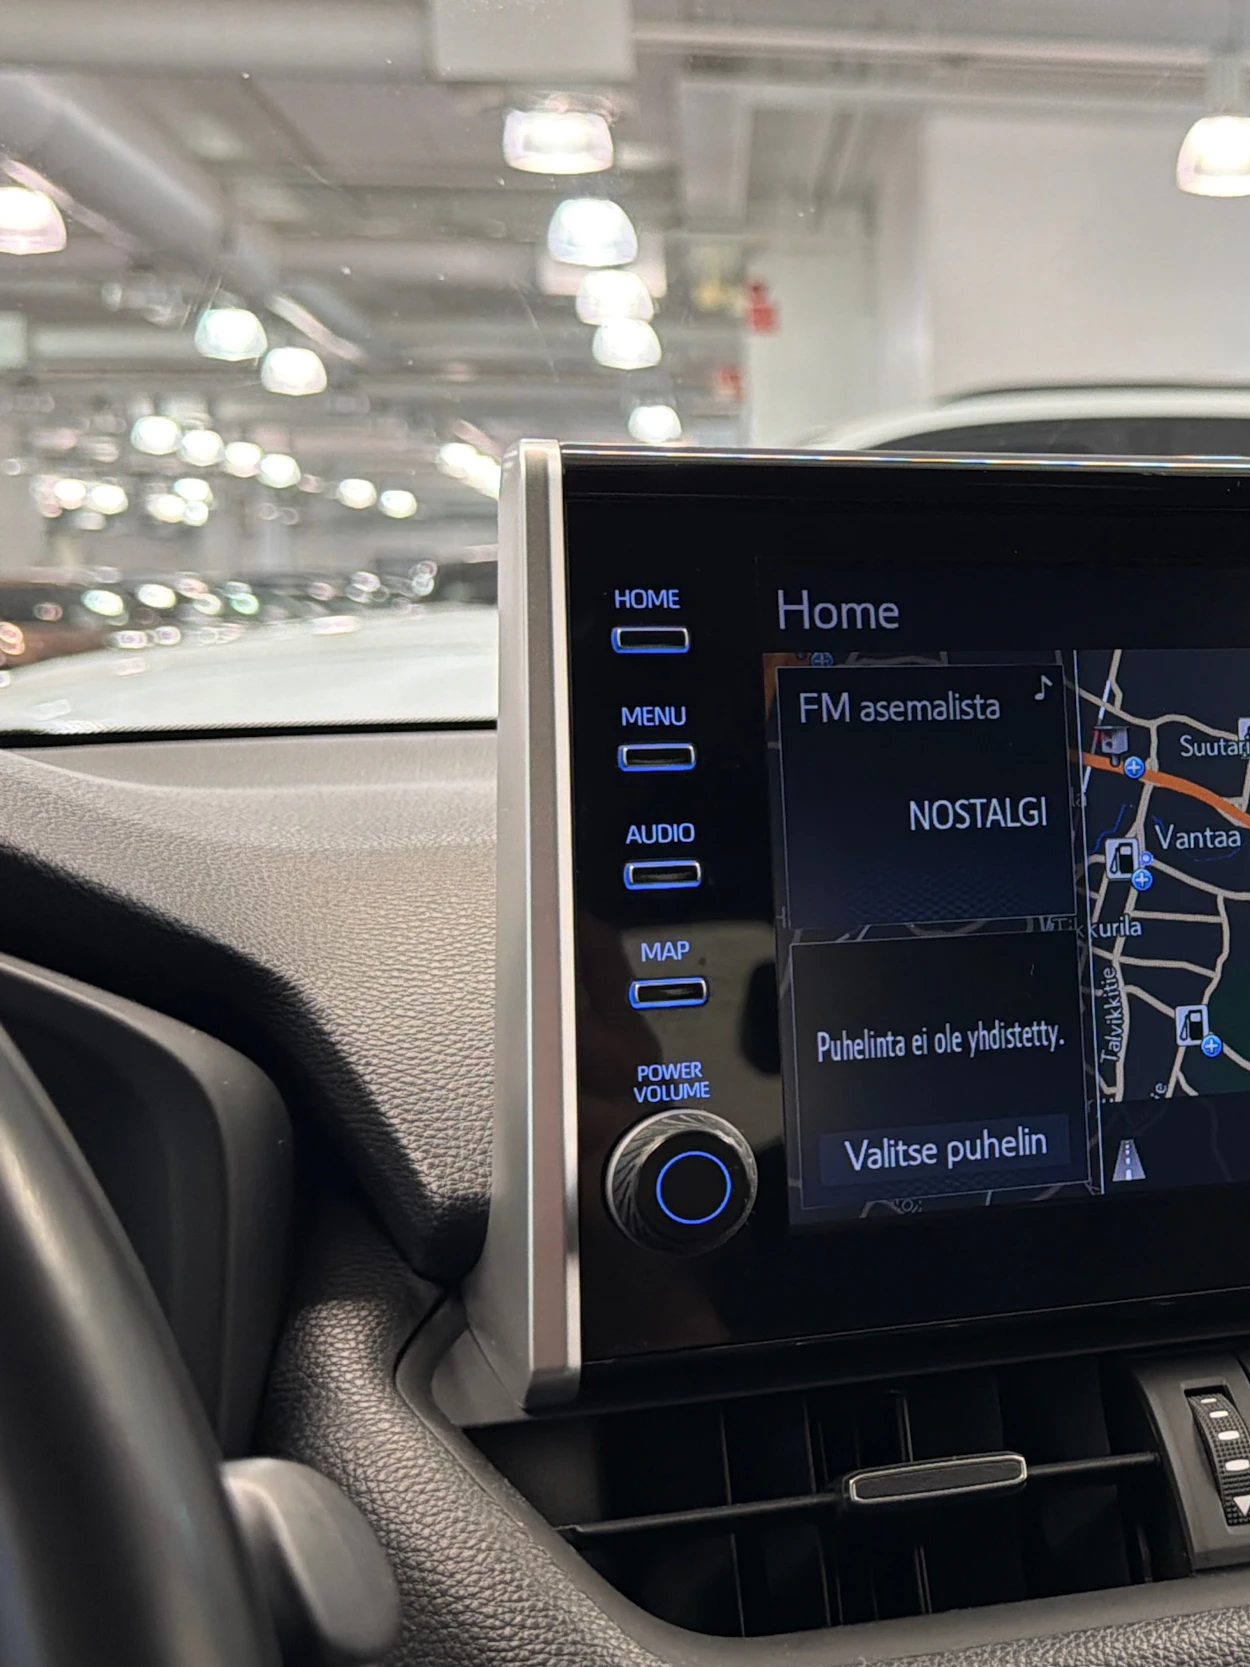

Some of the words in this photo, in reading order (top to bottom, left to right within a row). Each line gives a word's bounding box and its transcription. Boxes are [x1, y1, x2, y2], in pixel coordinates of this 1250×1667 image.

[613, 588, 681, 610] HOME
[777, 589, 901, 631] Home
[620, 706, 687, 727] MENU
[799, 691, 851, 724] FM
[859, 691, 1001, 722] asemalista
[909, 796, 1048, 832] NOSTALGI
[625, 823, 695, 845] AUDIO
[1155, 824, 1242, 850] Vantaa
[640, 941, 690, 962] MAP
[1100, 967, 1120, 1064] Talvikkitie
[817, 1027, 906, 1063] Puhelinta
[912, 1026, 927, 1055] ei
[934, 1024, 963, 1053] ole
[967, 1020, 1065, 1057] yhdistetty.
[637, 1062, 702, 1082] POWER
[633, 1080, 711, 1103] VOLUME
[845, 1135, 938, 1171] Valitse
[946, 1125, 1048, 1167] puhelin
